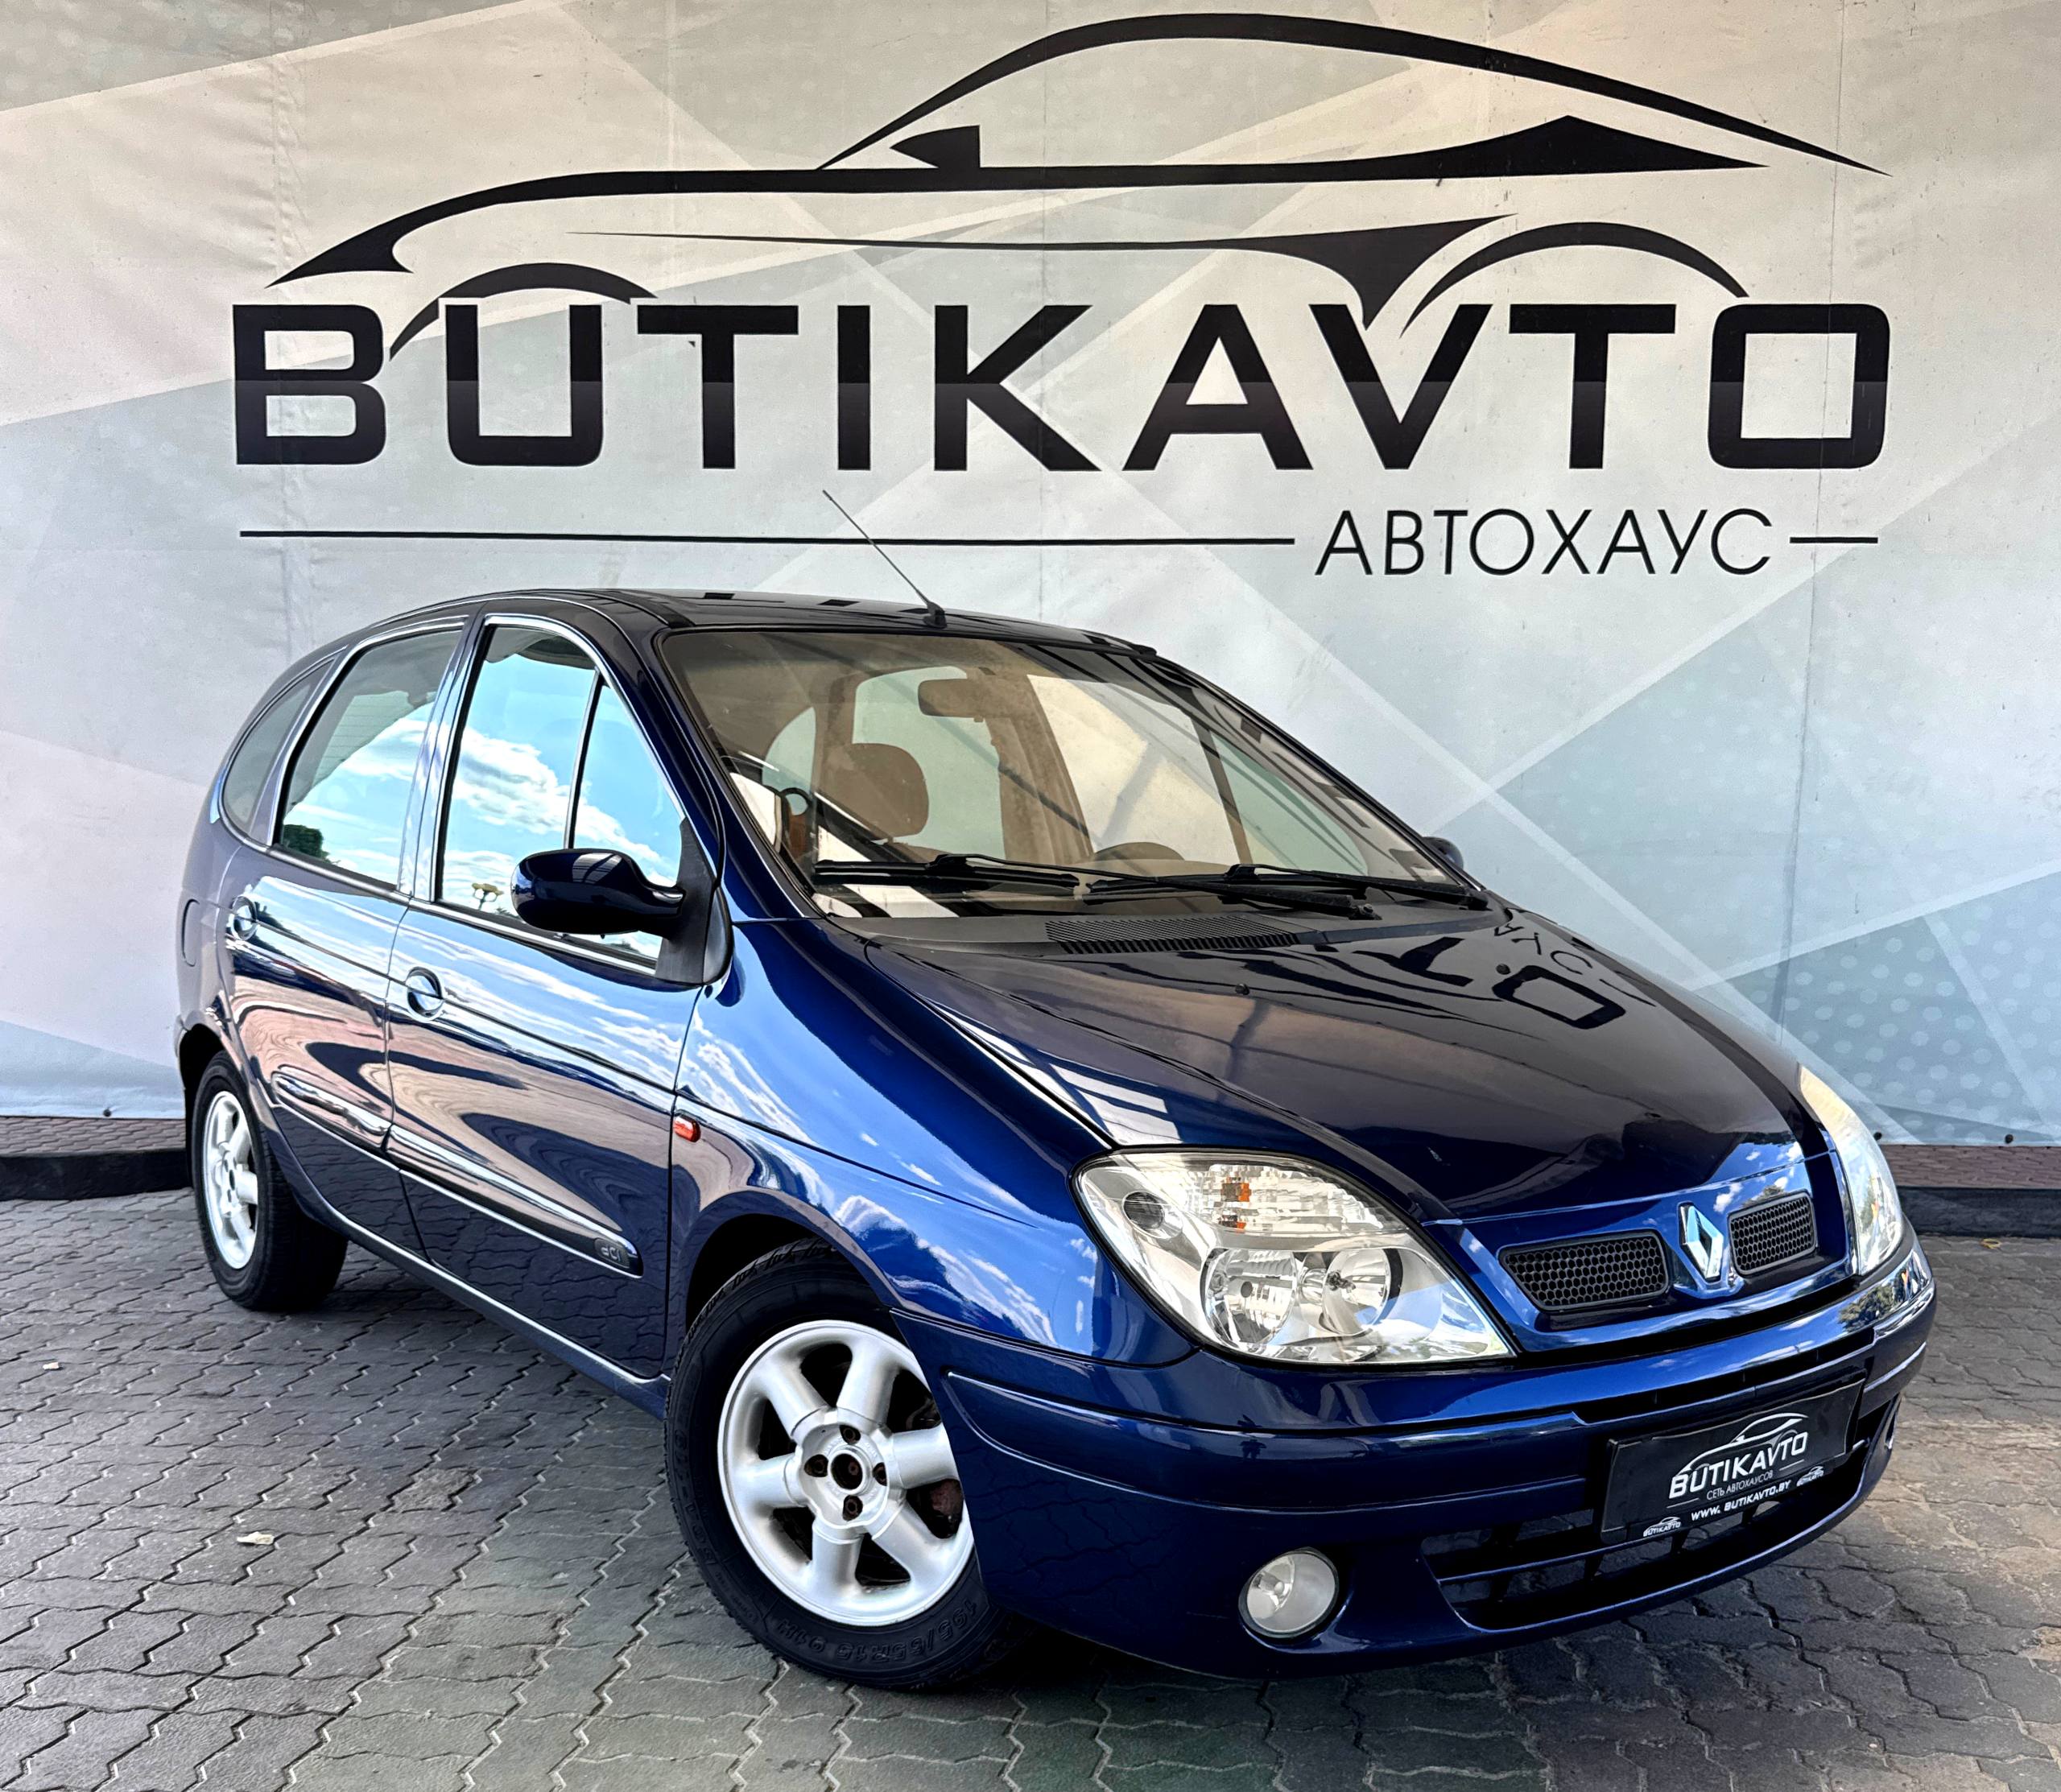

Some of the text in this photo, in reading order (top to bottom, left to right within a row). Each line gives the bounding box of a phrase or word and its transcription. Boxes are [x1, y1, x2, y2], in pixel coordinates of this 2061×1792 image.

[233, 303, 1890, 473] BUTIKAVTO
[1314, 507, 1772, 576] АВТОХАУС
[1669, 1431, 1809, 1499] BUTIKAVTO
[1706, 1470, 1774, 1500] СЕТЬ АВТОХАУСОВ
[1724, 1480, 1792, 1512] BUTIKAVTO.BY
[1643, 1521, 1682, 1538] BUTIKAVTO
